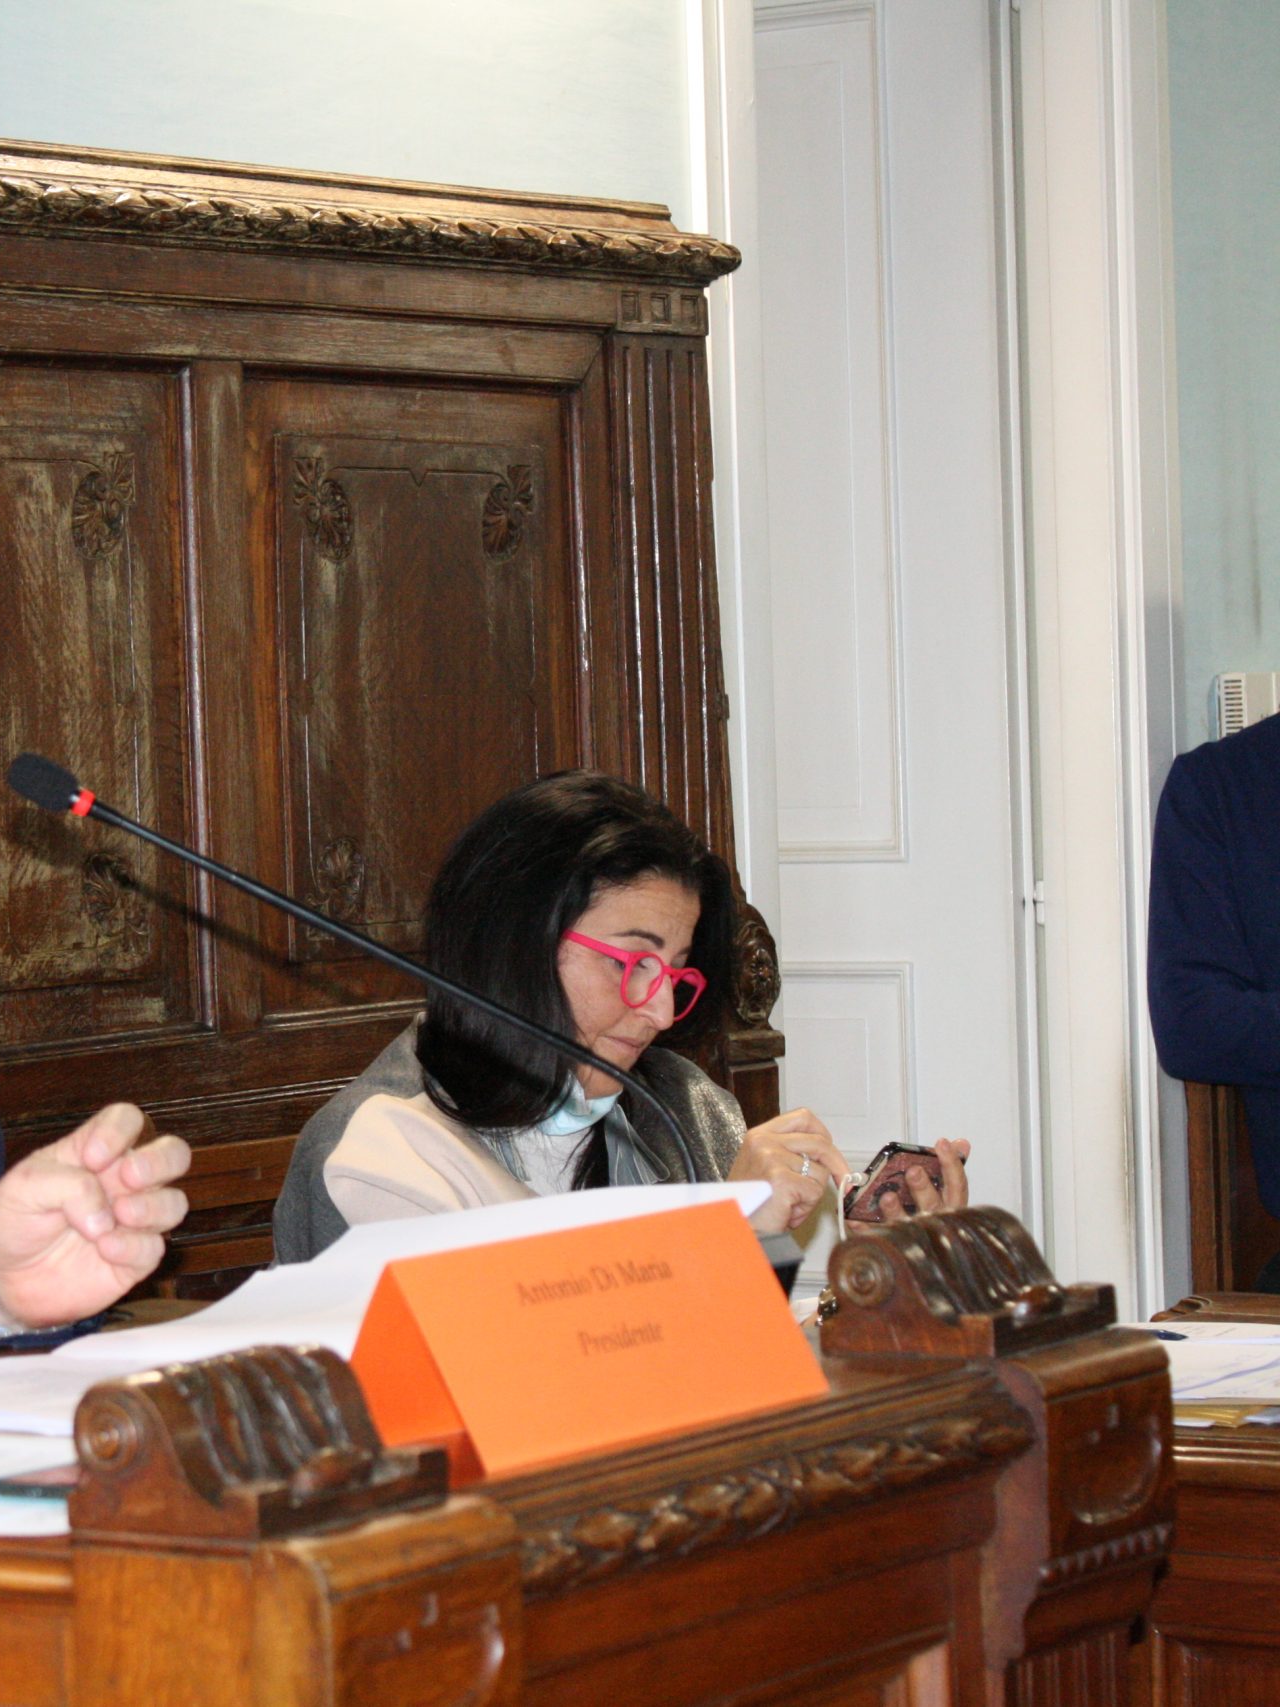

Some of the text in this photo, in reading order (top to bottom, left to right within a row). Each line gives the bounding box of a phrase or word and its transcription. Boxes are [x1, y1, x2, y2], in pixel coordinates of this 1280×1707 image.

[516, 1257, 673, 1305] Antonio Di Maria
[578, 1322, 664, 1356] Presidente
